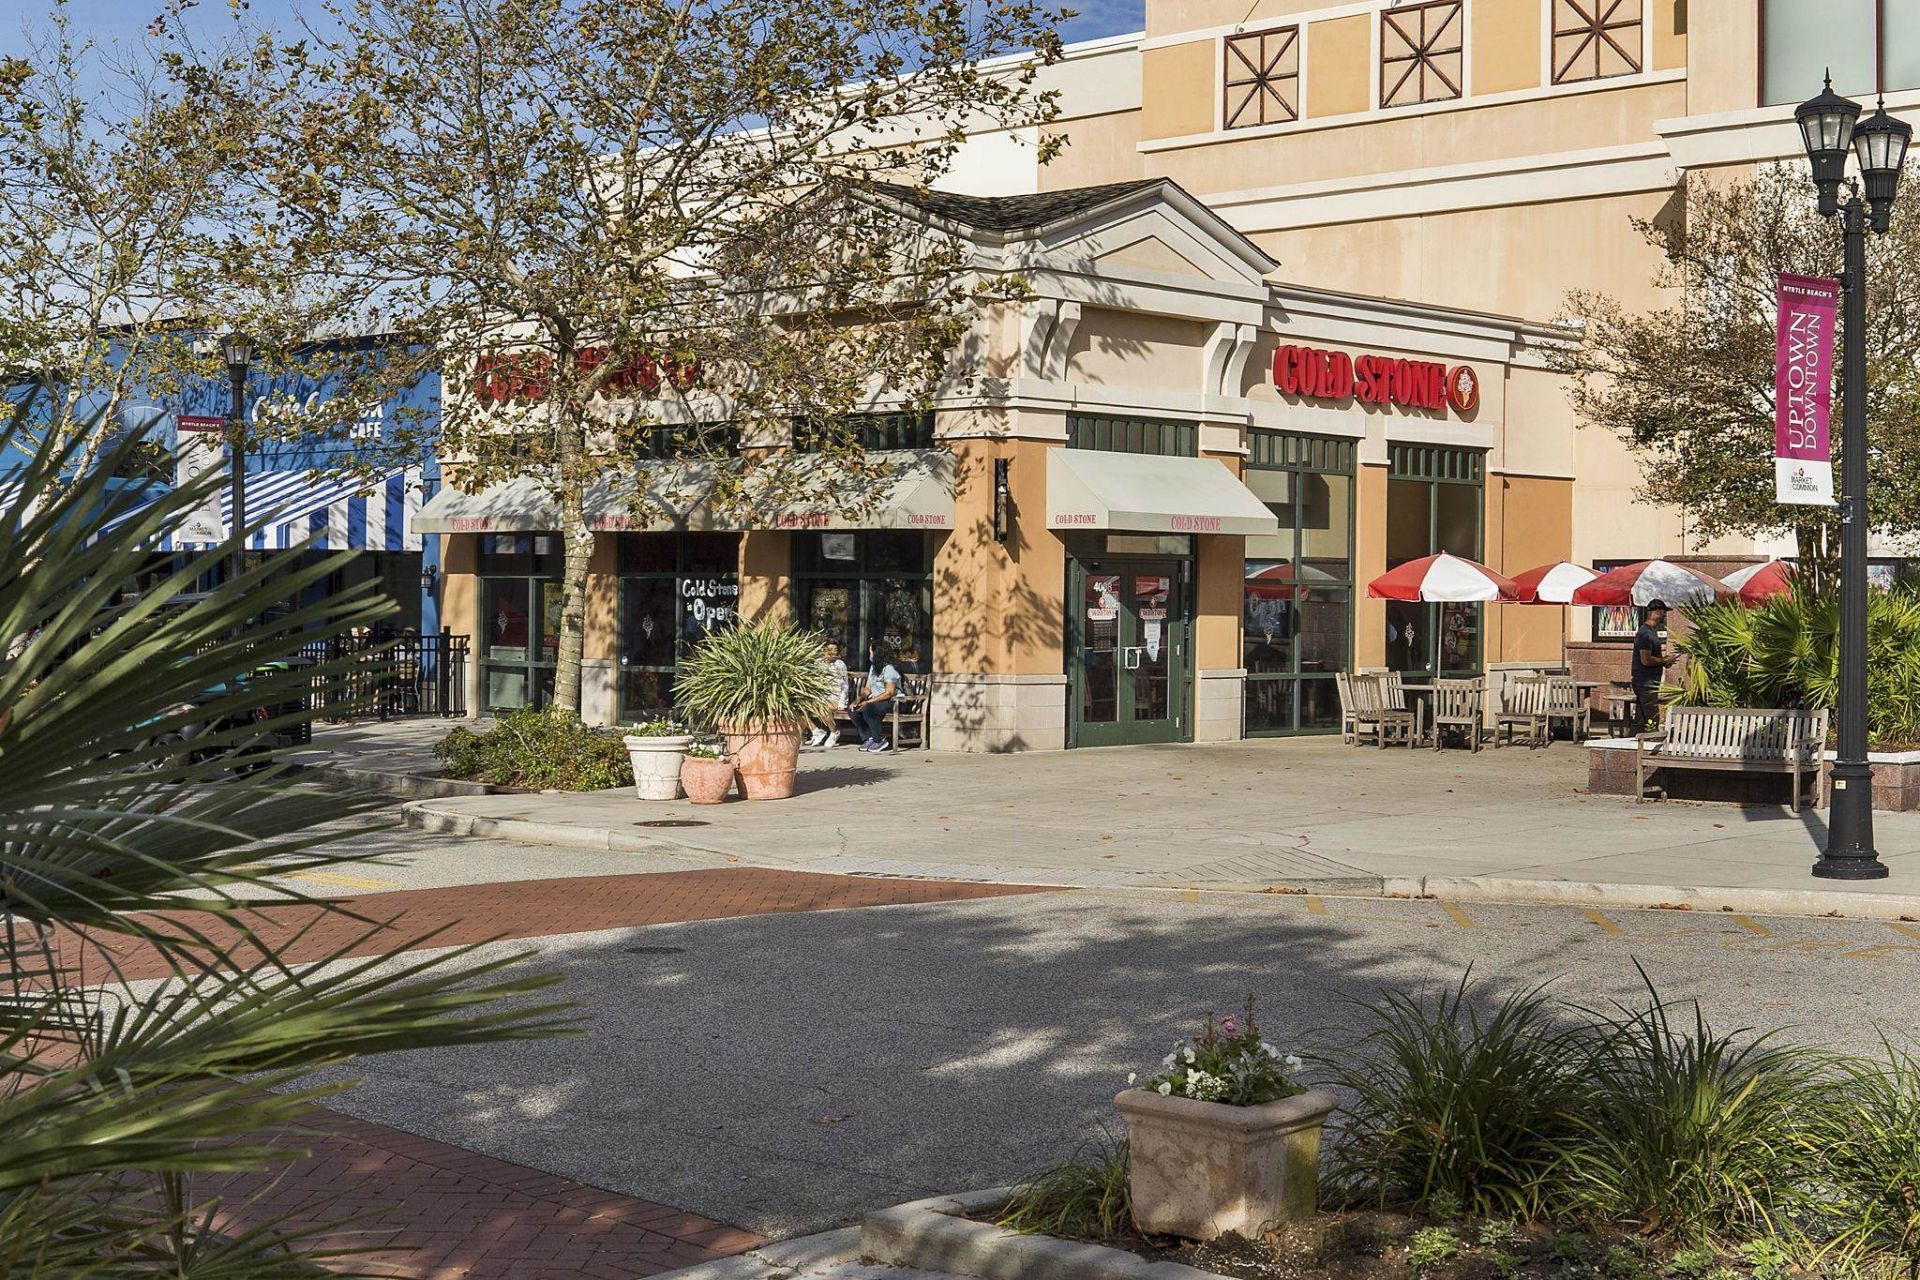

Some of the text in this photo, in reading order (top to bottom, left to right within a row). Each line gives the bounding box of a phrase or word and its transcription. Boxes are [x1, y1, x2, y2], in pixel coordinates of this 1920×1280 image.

[1783, 285, 1832, 298] MYRTLE BEACH'S
[1273, 345, 1448, 410] COLD STONE
[1788, 310, 1807, 449] UPTOWN
[1804, 313, 1821, 449] DOWNTOWN
[349, 421, 382, 439] CAFE
[776, 511, 830, 529] COLD STONE
[907, 513, 946, 525] COLD STONE
[1055, 513, 1097, 525] COLD STONE
[1171, 515, 1221, 531] COLD STONE
[682, 578, 739, 597] Cold Stone
